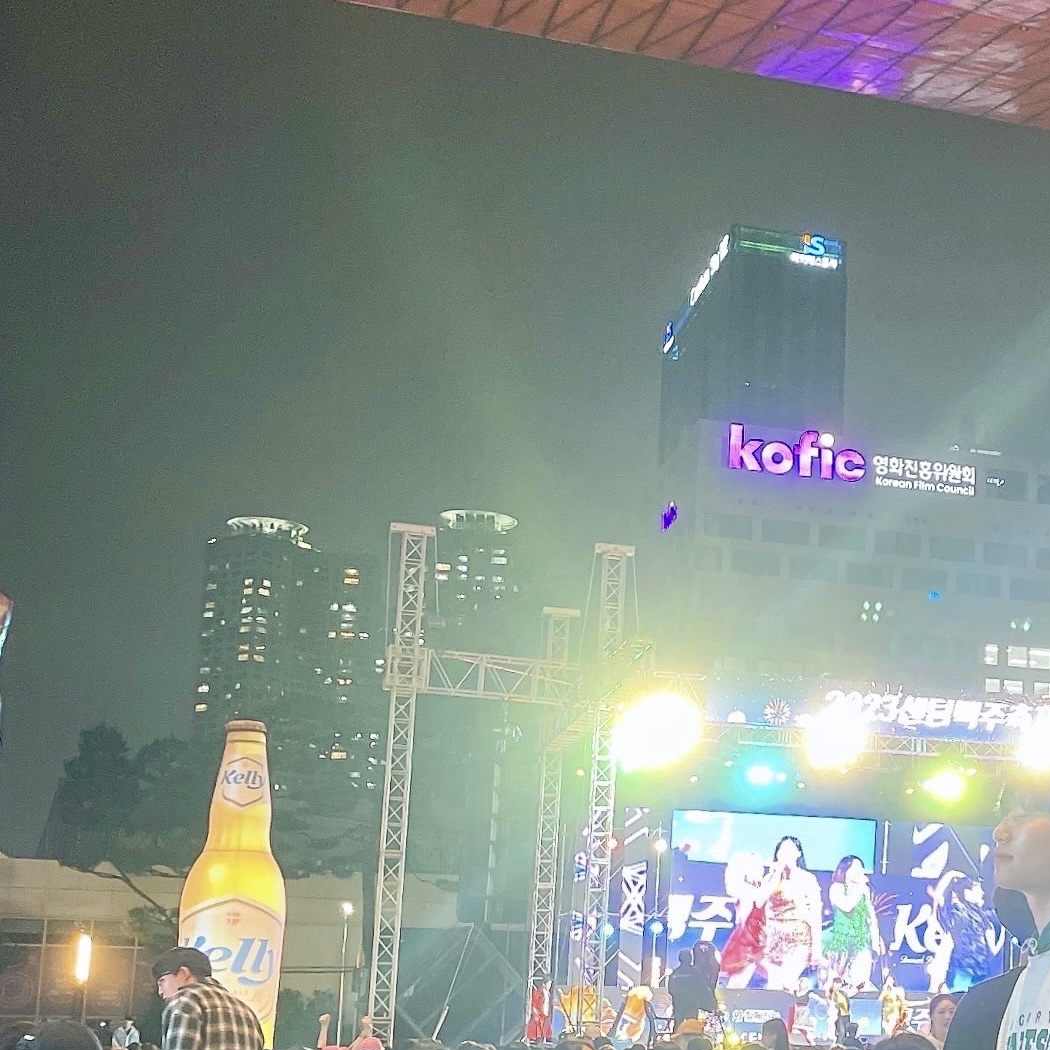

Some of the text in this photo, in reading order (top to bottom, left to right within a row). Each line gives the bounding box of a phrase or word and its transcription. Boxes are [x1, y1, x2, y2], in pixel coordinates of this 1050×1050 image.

[728, 422, 866, 483] kofic
[873, 455, 976, 485] 영화진흥위원회
[875, 476, 912, 490] Korean
[913, 480, 935, 491] Film
[936, 482, 975, 496] Council
[221, 769, 266, 790] Kelly
